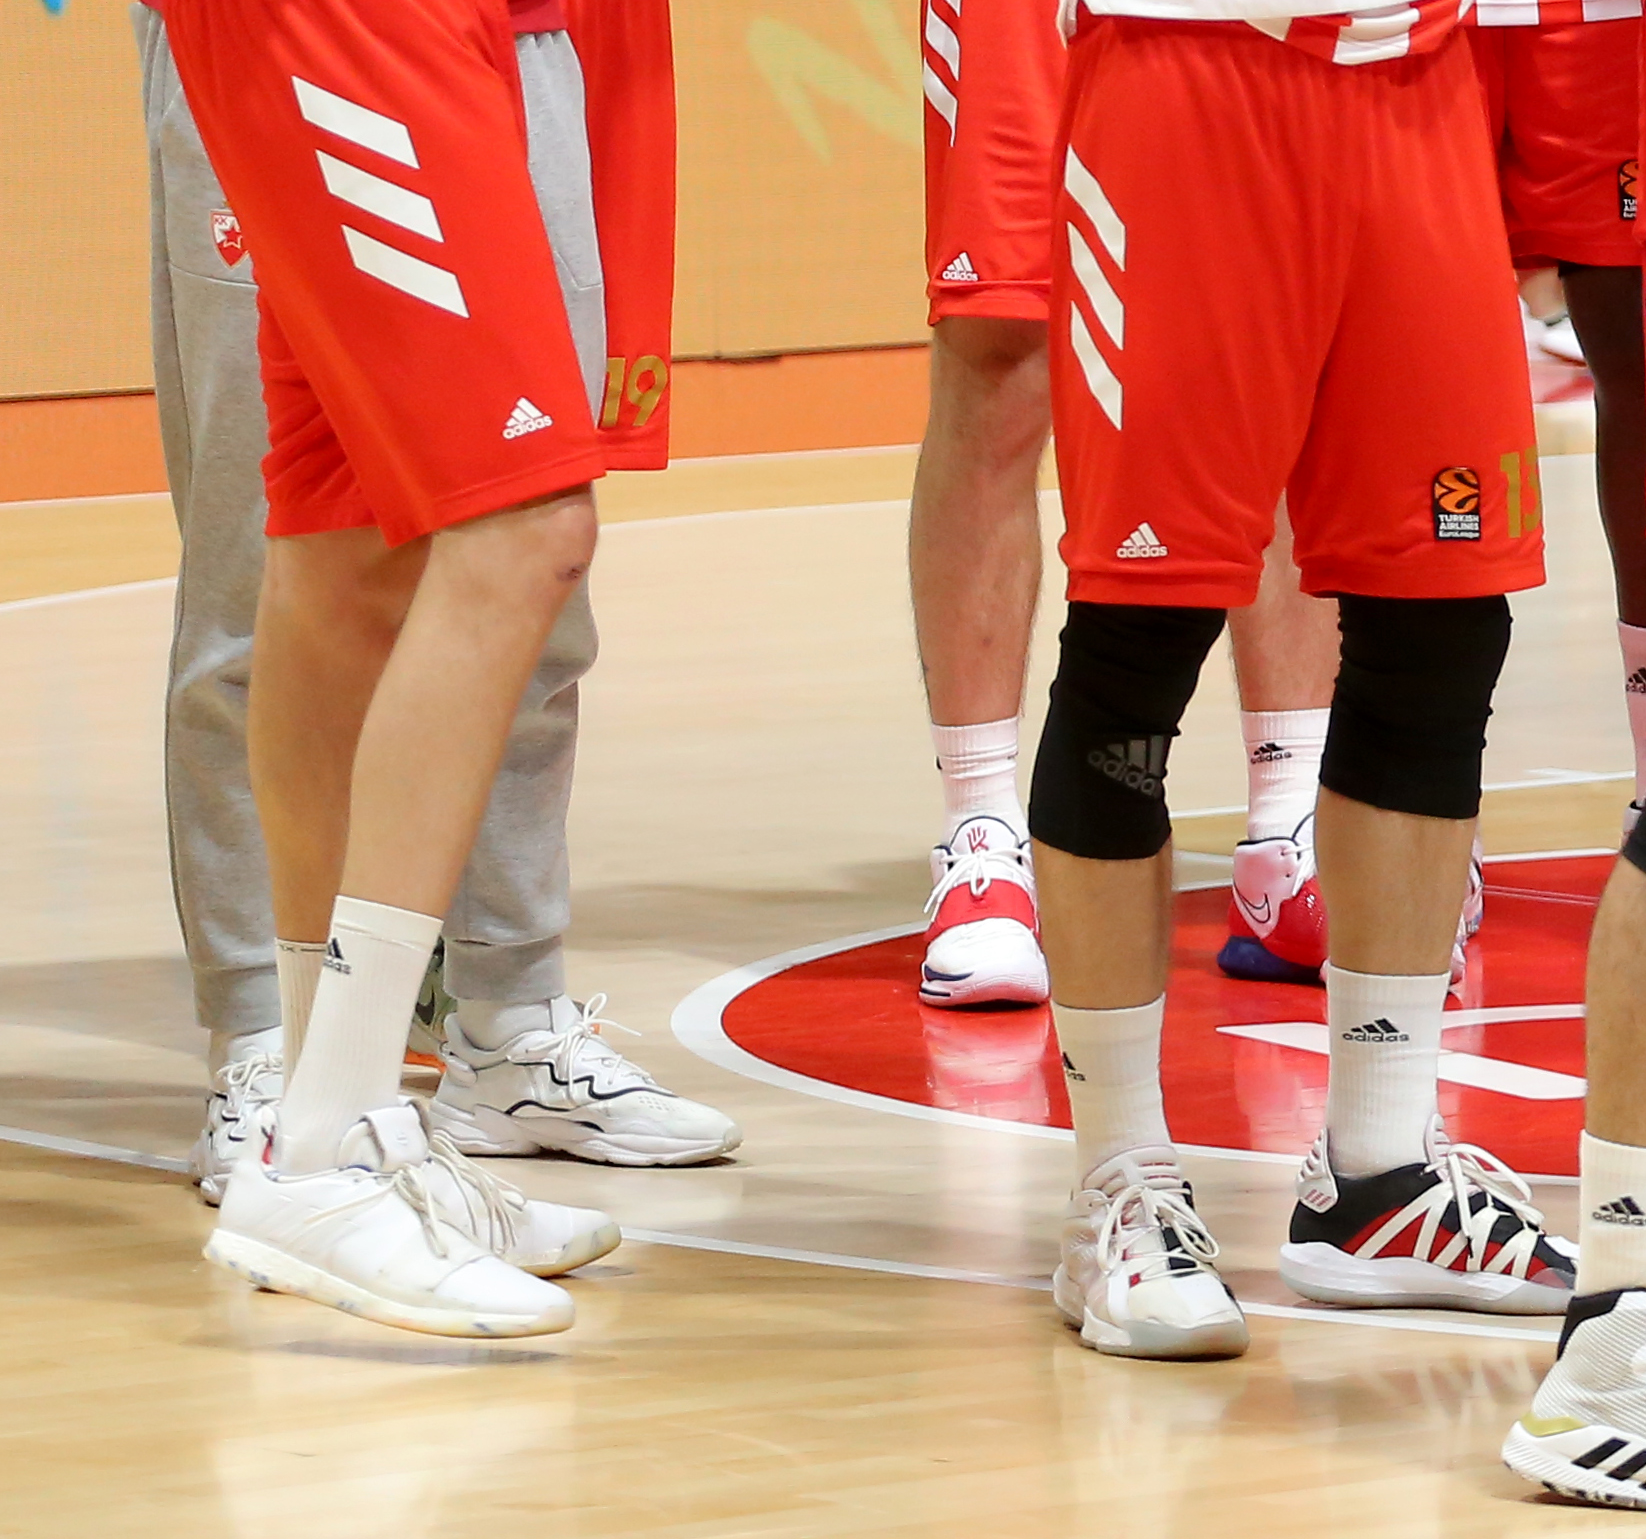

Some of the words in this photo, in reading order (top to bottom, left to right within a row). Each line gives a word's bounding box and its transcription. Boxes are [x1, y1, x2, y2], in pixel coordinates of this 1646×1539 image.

[942, 270, 978, 282] adidas
[600, 355, 668, 427] 19
[502, 414, 554, 439] adidas
[1500, 451, 1541, 539] 13
[1438, 514, 1480, 522] TURKISH
[1438, 522, 1480, 531] AIRLINES
[1116, 545, 1168, 559] adidas
[1250, 750, 1292, 765] adidas
[1342, 1030, 1410, 1043] adidas
